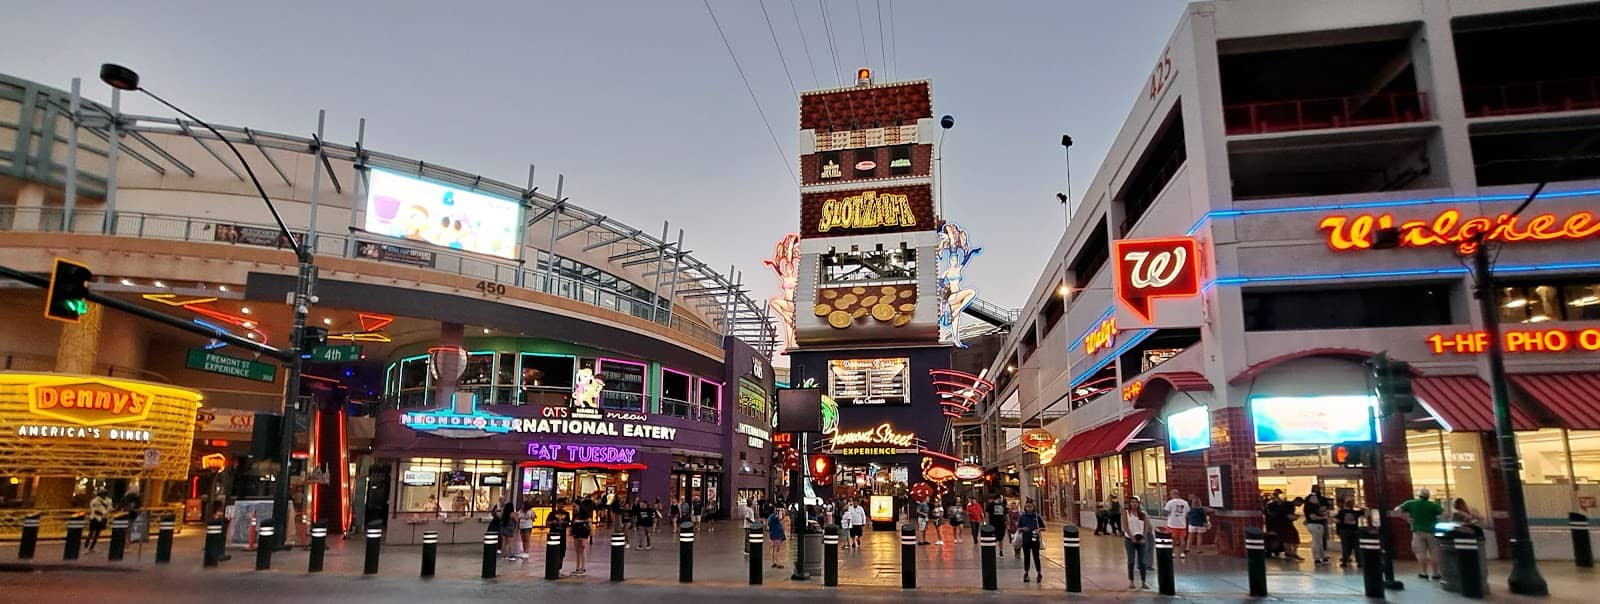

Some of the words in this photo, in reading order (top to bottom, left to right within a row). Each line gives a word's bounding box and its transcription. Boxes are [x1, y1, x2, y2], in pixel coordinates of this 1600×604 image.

[1150, 47, 1171, 100] 425
[1124, 246, 1187, 288] W
[476, 281, 505, 295] 450
[206, 354, 240, 366] FREMONT
[241, 360, 250, 368] ST
[324, 350, 341, 361] 4th
[205, 363, 249, 377] EXPERIENCE
[38, 387, 145, 414] Denny's
[543, 407, 567, 418] CAT'S
[607, 411, 647, 421] meow
[18, 425, 101, 438] AMERICA'S
[109, 429, 151, 441] DINER
[512, 419, 619, 436] RNATIONAL
[623, 424, 677, 440] EATERY
[829, 427, 874, 451] Fremont
[873, 423, 915, 447] Street
[528, 443, 562, 459] FAT
[567, 445, 636, 463] TUESDAY
[842, 447, 897, 455] EXPERIENCE
